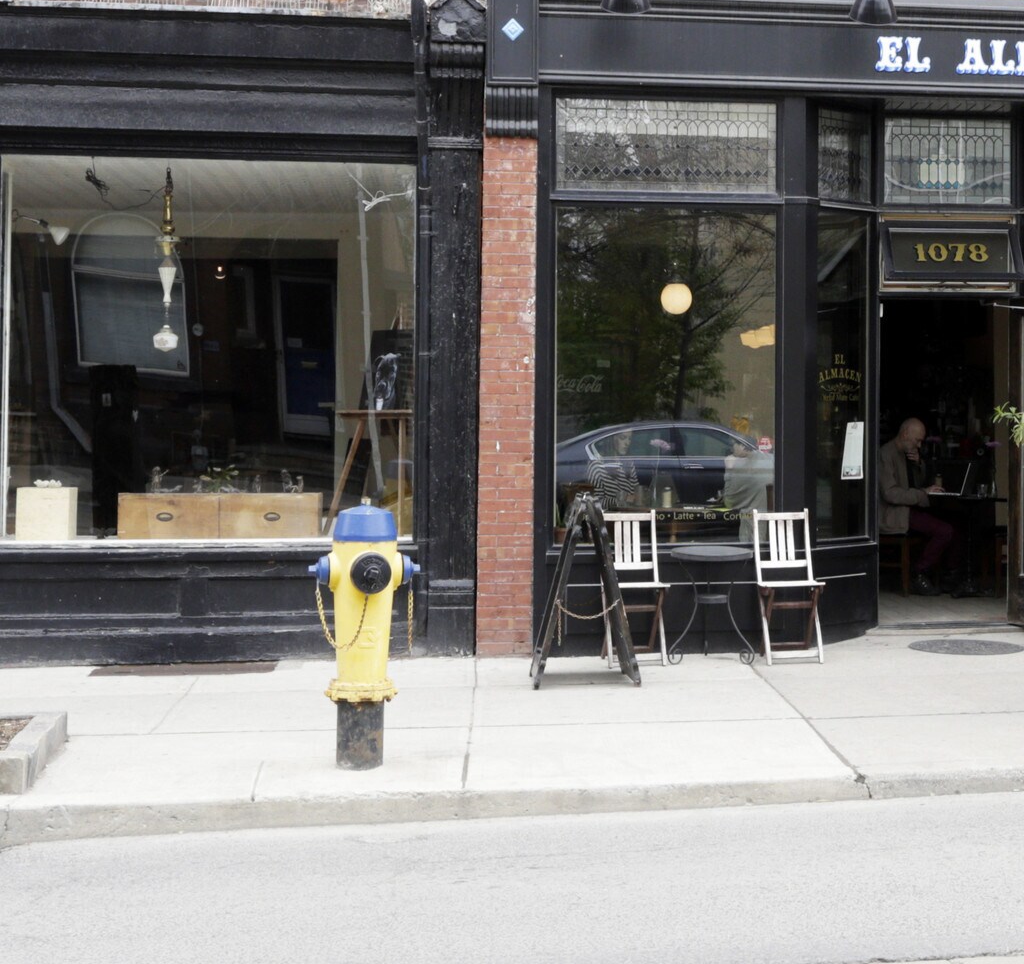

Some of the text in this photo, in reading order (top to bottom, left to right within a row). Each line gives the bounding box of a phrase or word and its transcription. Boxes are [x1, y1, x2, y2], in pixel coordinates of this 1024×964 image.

[875, 36, 931, 72] EL
[914, 242, 989, 262] 1078
[834, 353, 846, 365] EL
[819, 367, 862, 383] ALMACEN
[673, 511, 694, 521] Latte
[703, 511, 717, 520] Tea
